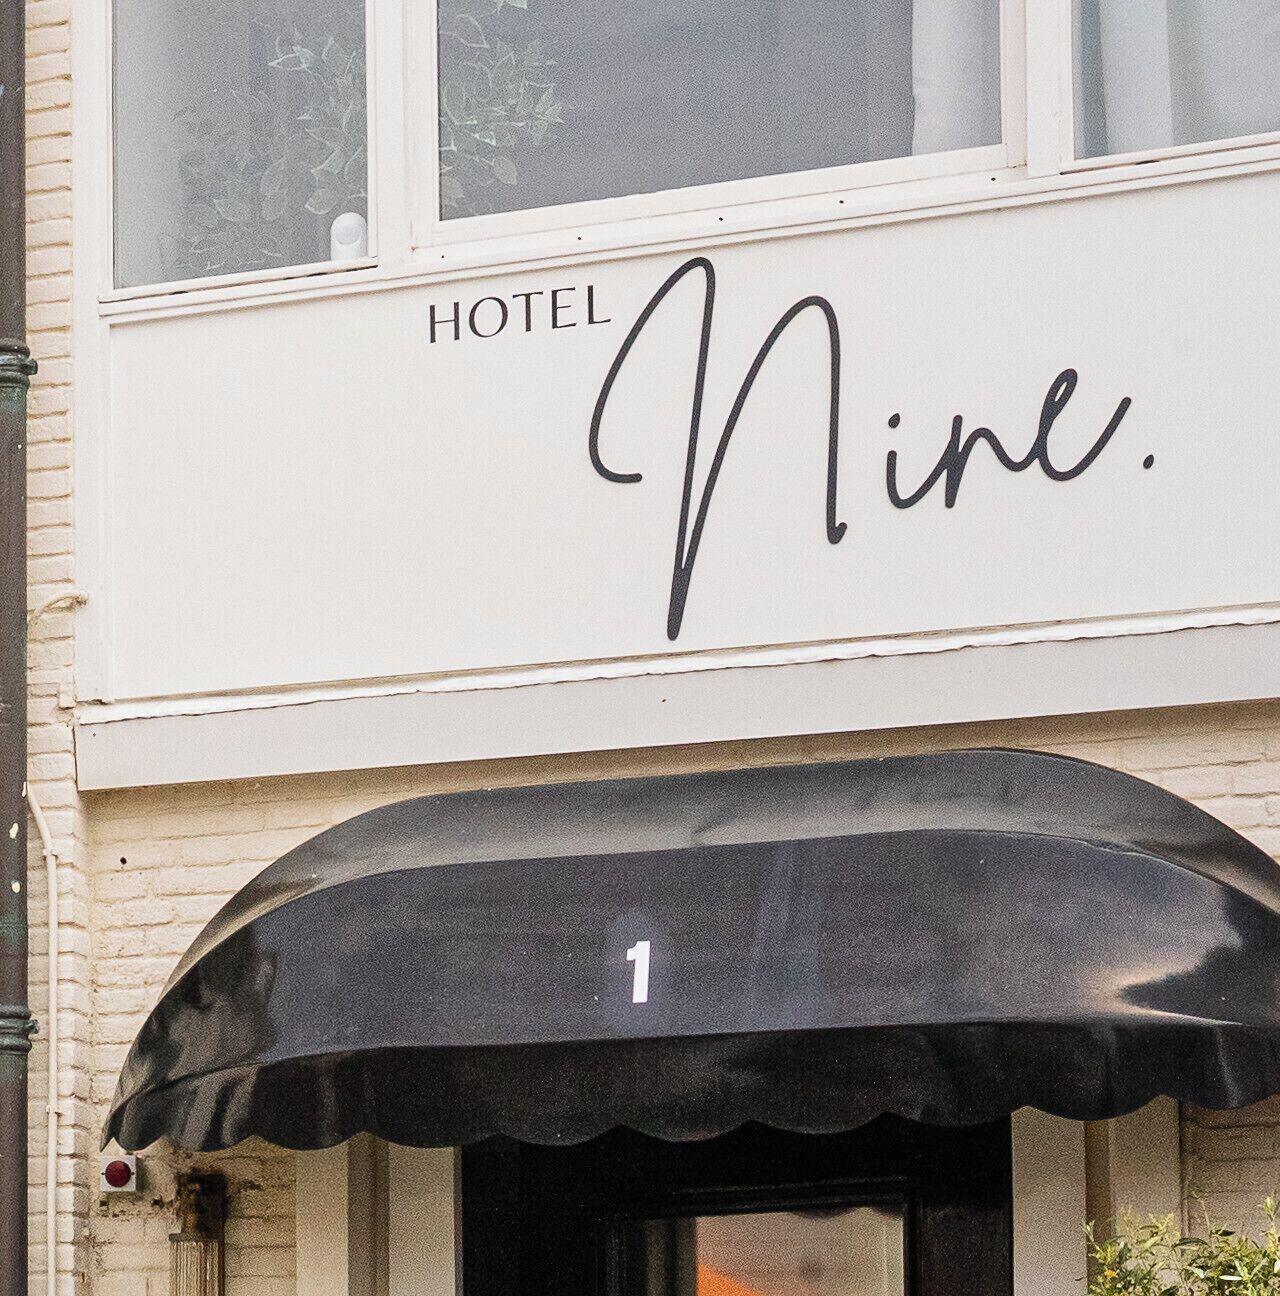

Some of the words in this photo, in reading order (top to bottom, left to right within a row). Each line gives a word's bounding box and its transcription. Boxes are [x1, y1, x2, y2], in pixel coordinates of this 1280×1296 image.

[428, 284, 613, 344] HOTEL
[588, 256, 1157, 642] Nine.
[626, 940, 651, 1004] 1
